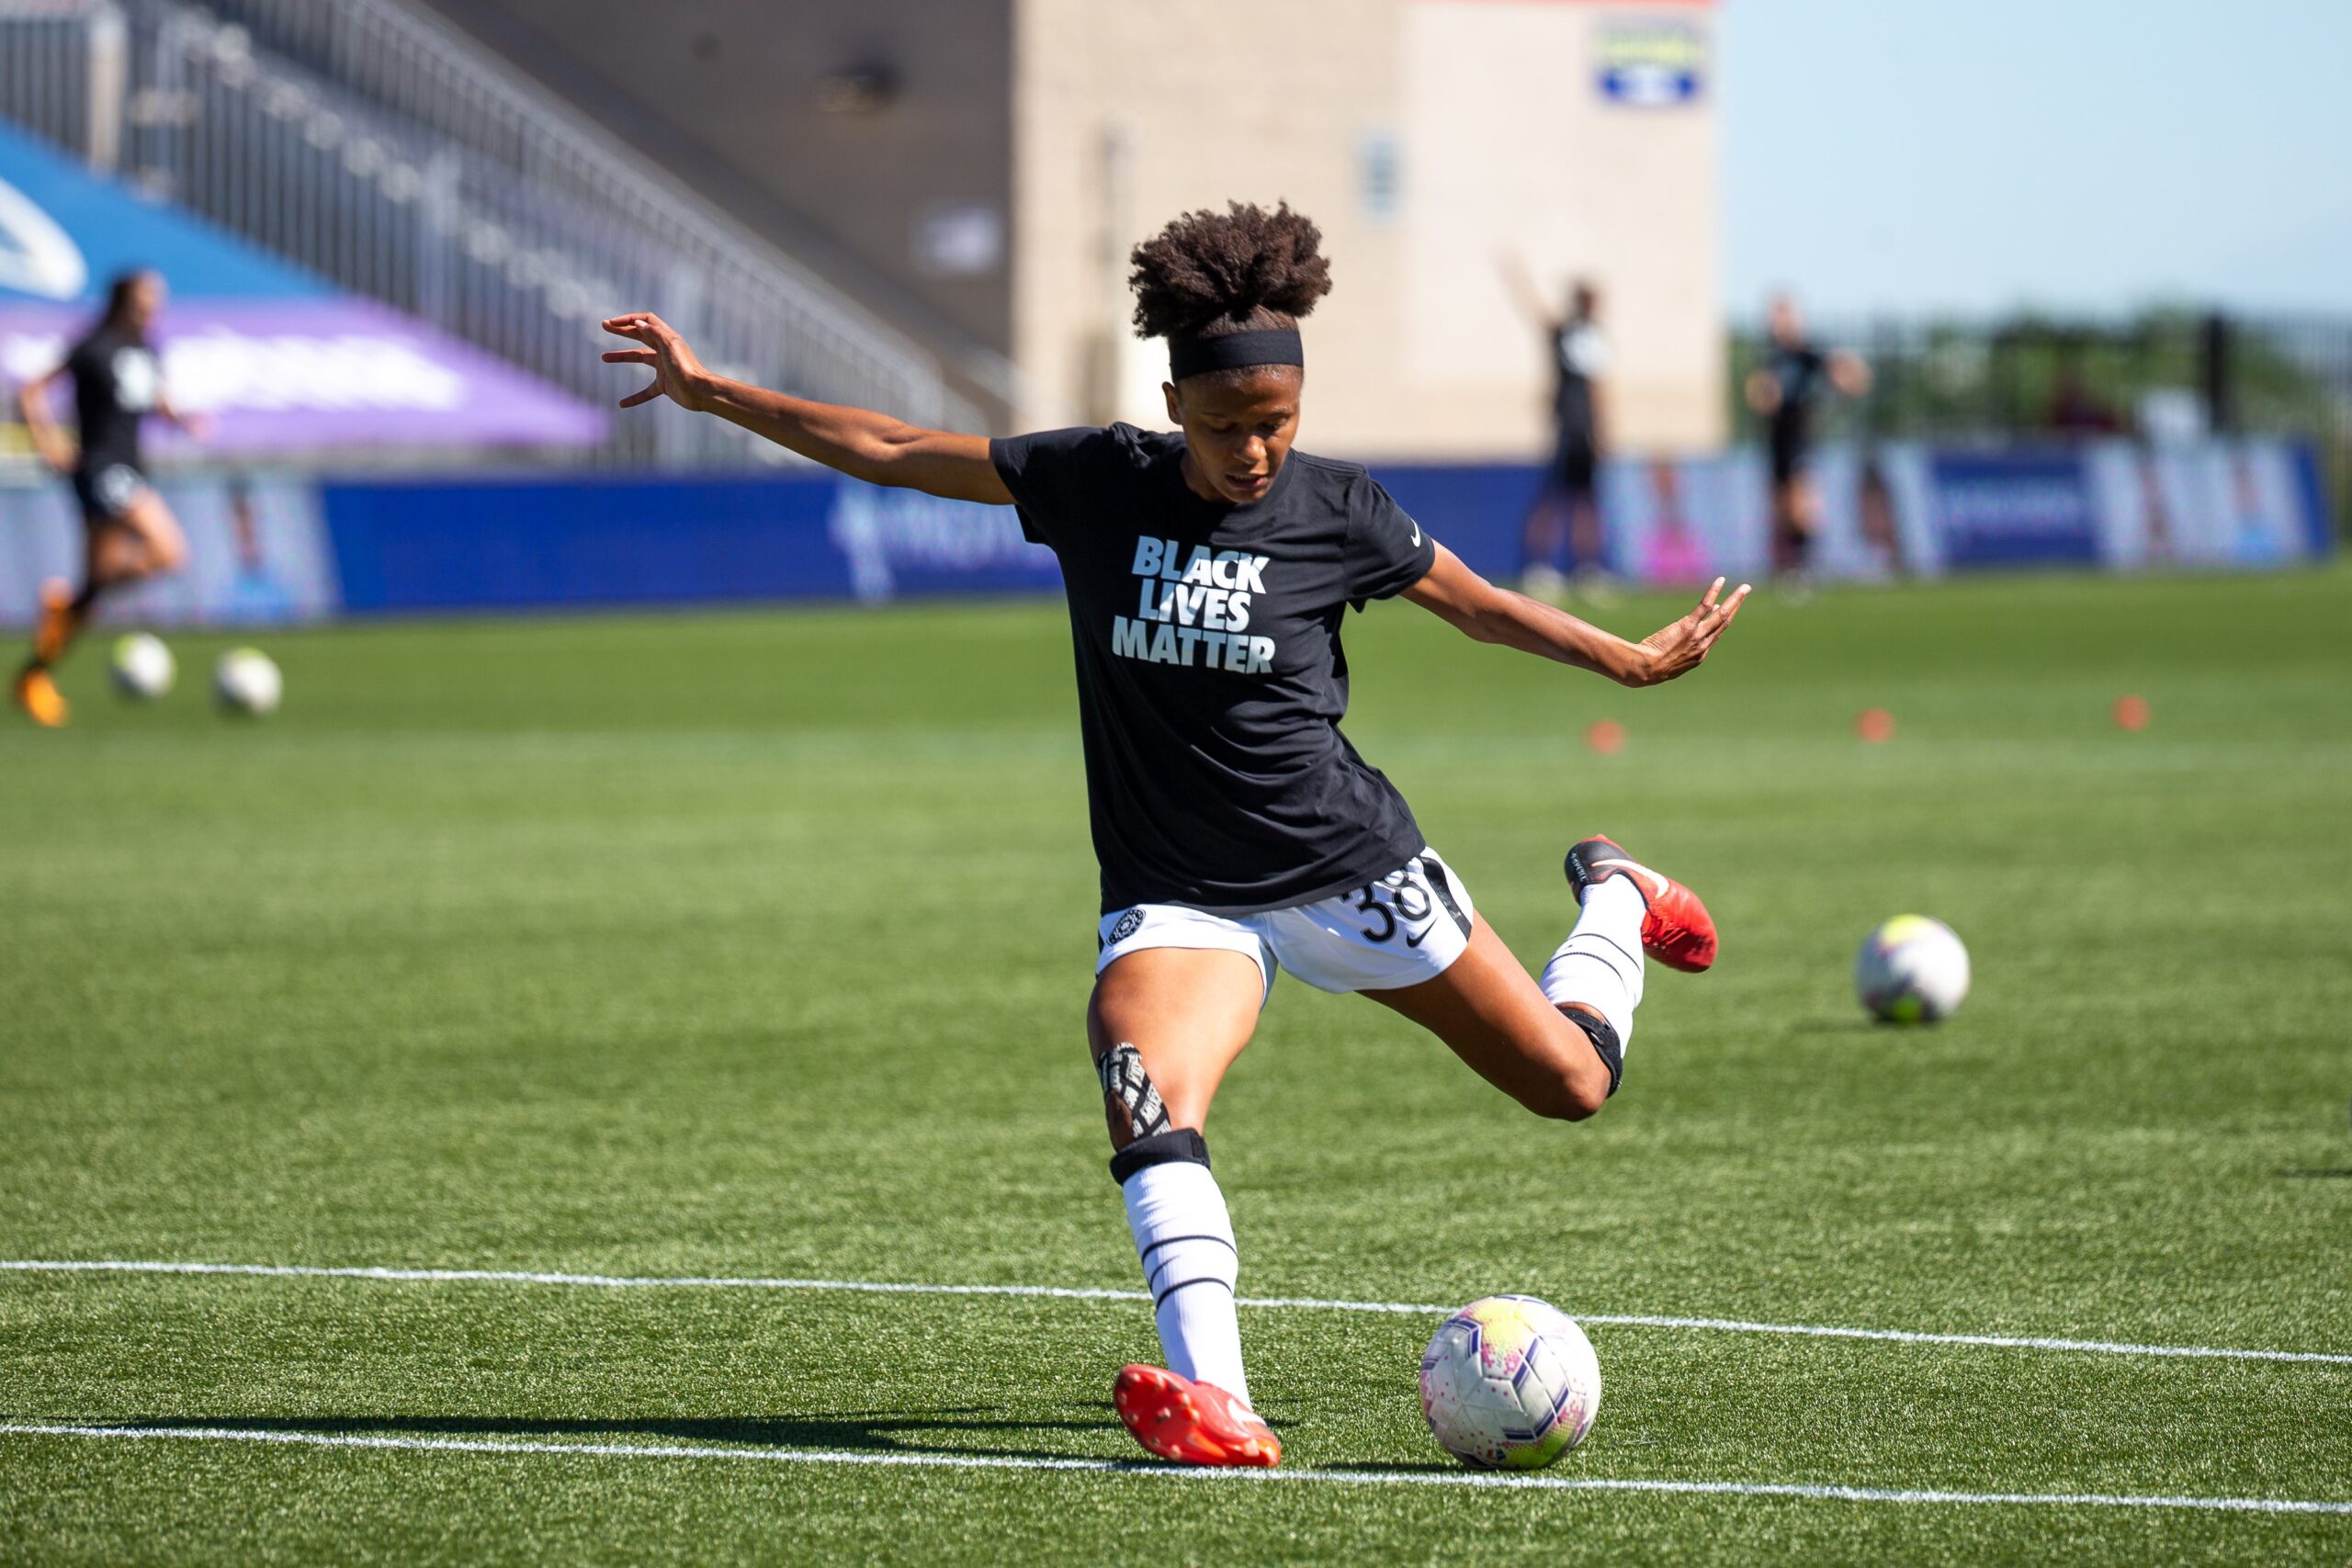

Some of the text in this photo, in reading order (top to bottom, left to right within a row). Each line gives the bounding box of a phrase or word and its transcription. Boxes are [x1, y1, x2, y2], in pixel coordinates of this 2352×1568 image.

[1131, 536, 1270, 594] BLACK
[1138, 578, 1251, 632] LIVES
[1112, 615, 1276, 675] MATTER
[1340, 864, 1431, 944] 38
